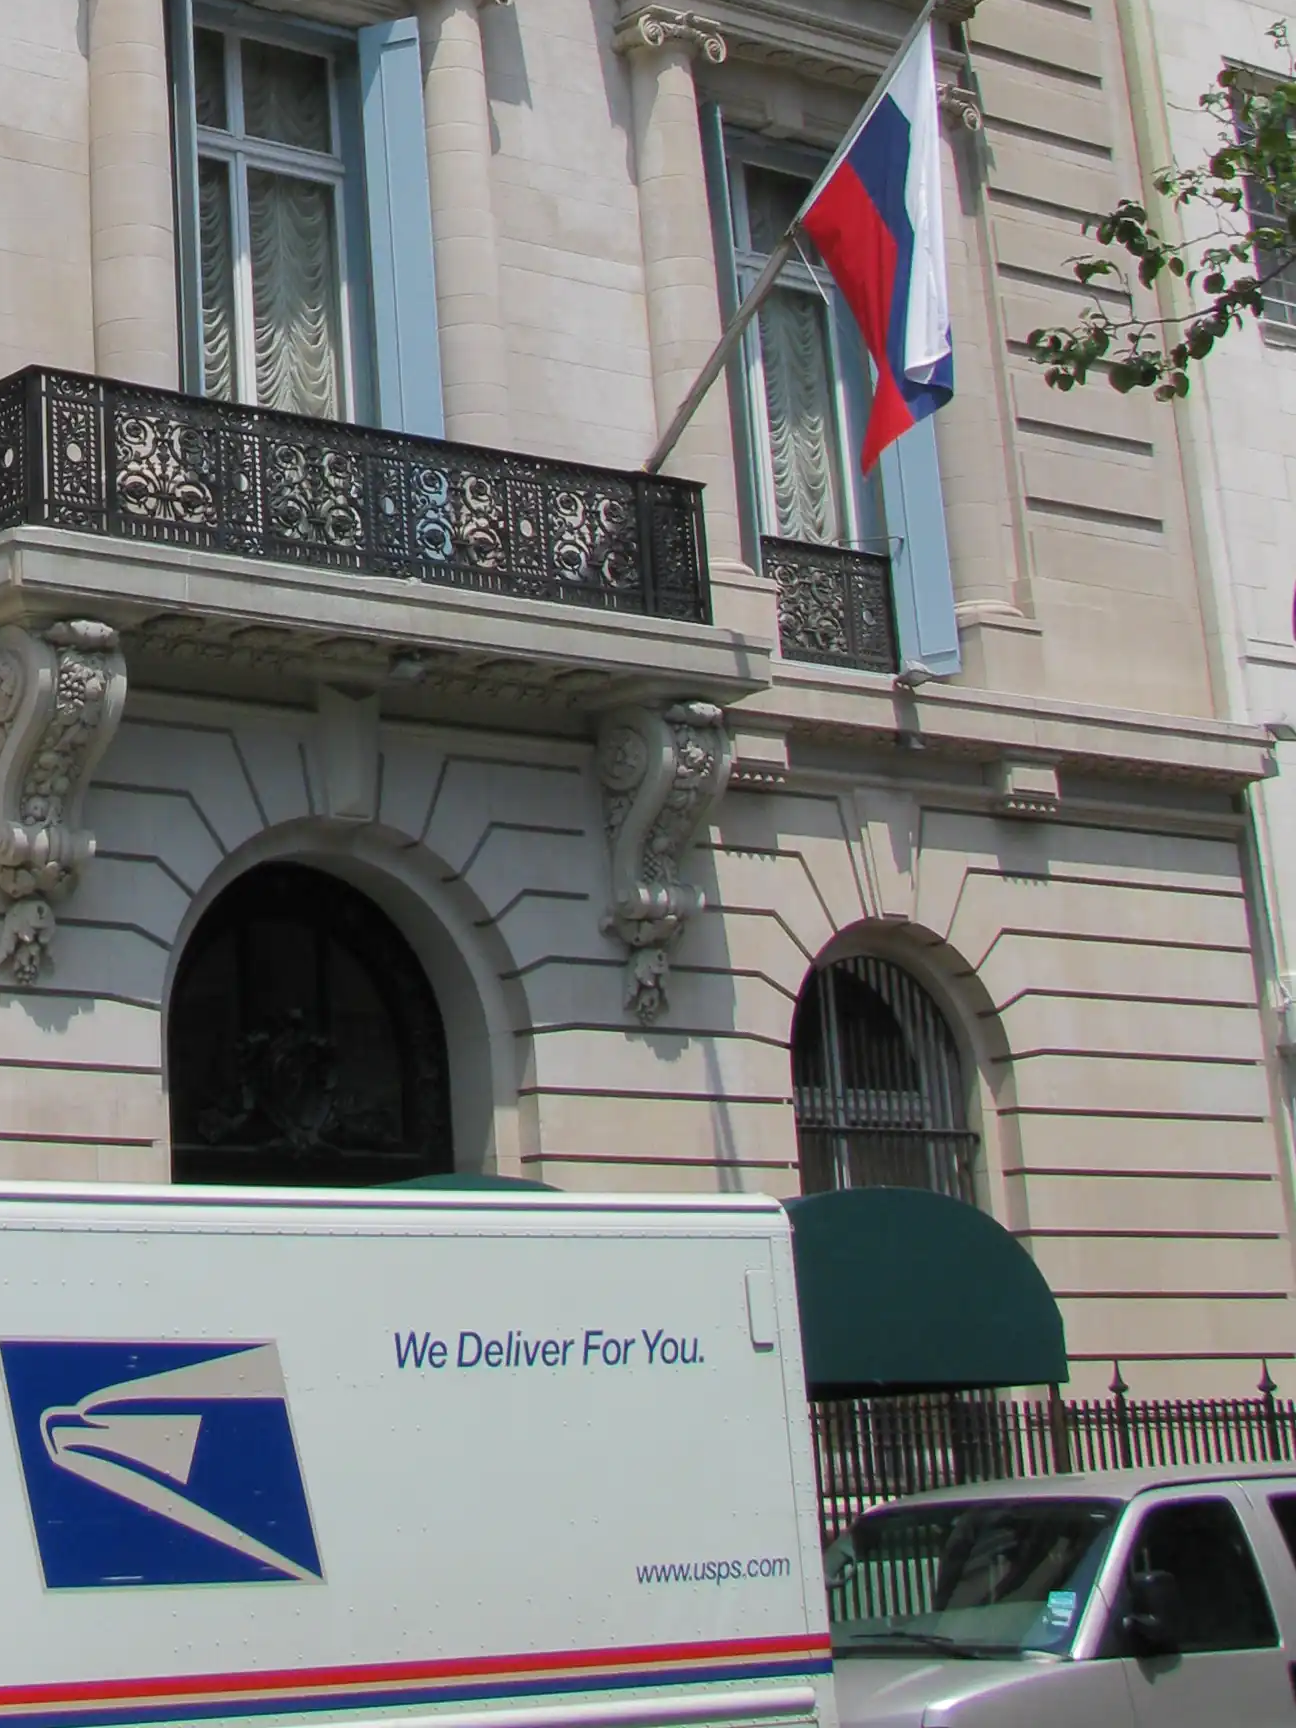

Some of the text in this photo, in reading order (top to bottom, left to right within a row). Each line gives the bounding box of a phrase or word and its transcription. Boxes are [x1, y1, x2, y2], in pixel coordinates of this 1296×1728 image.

[394, 1328, 705, 1369] We Deliver For You.
[635, 1556, 791, 1586] www.usps.com
